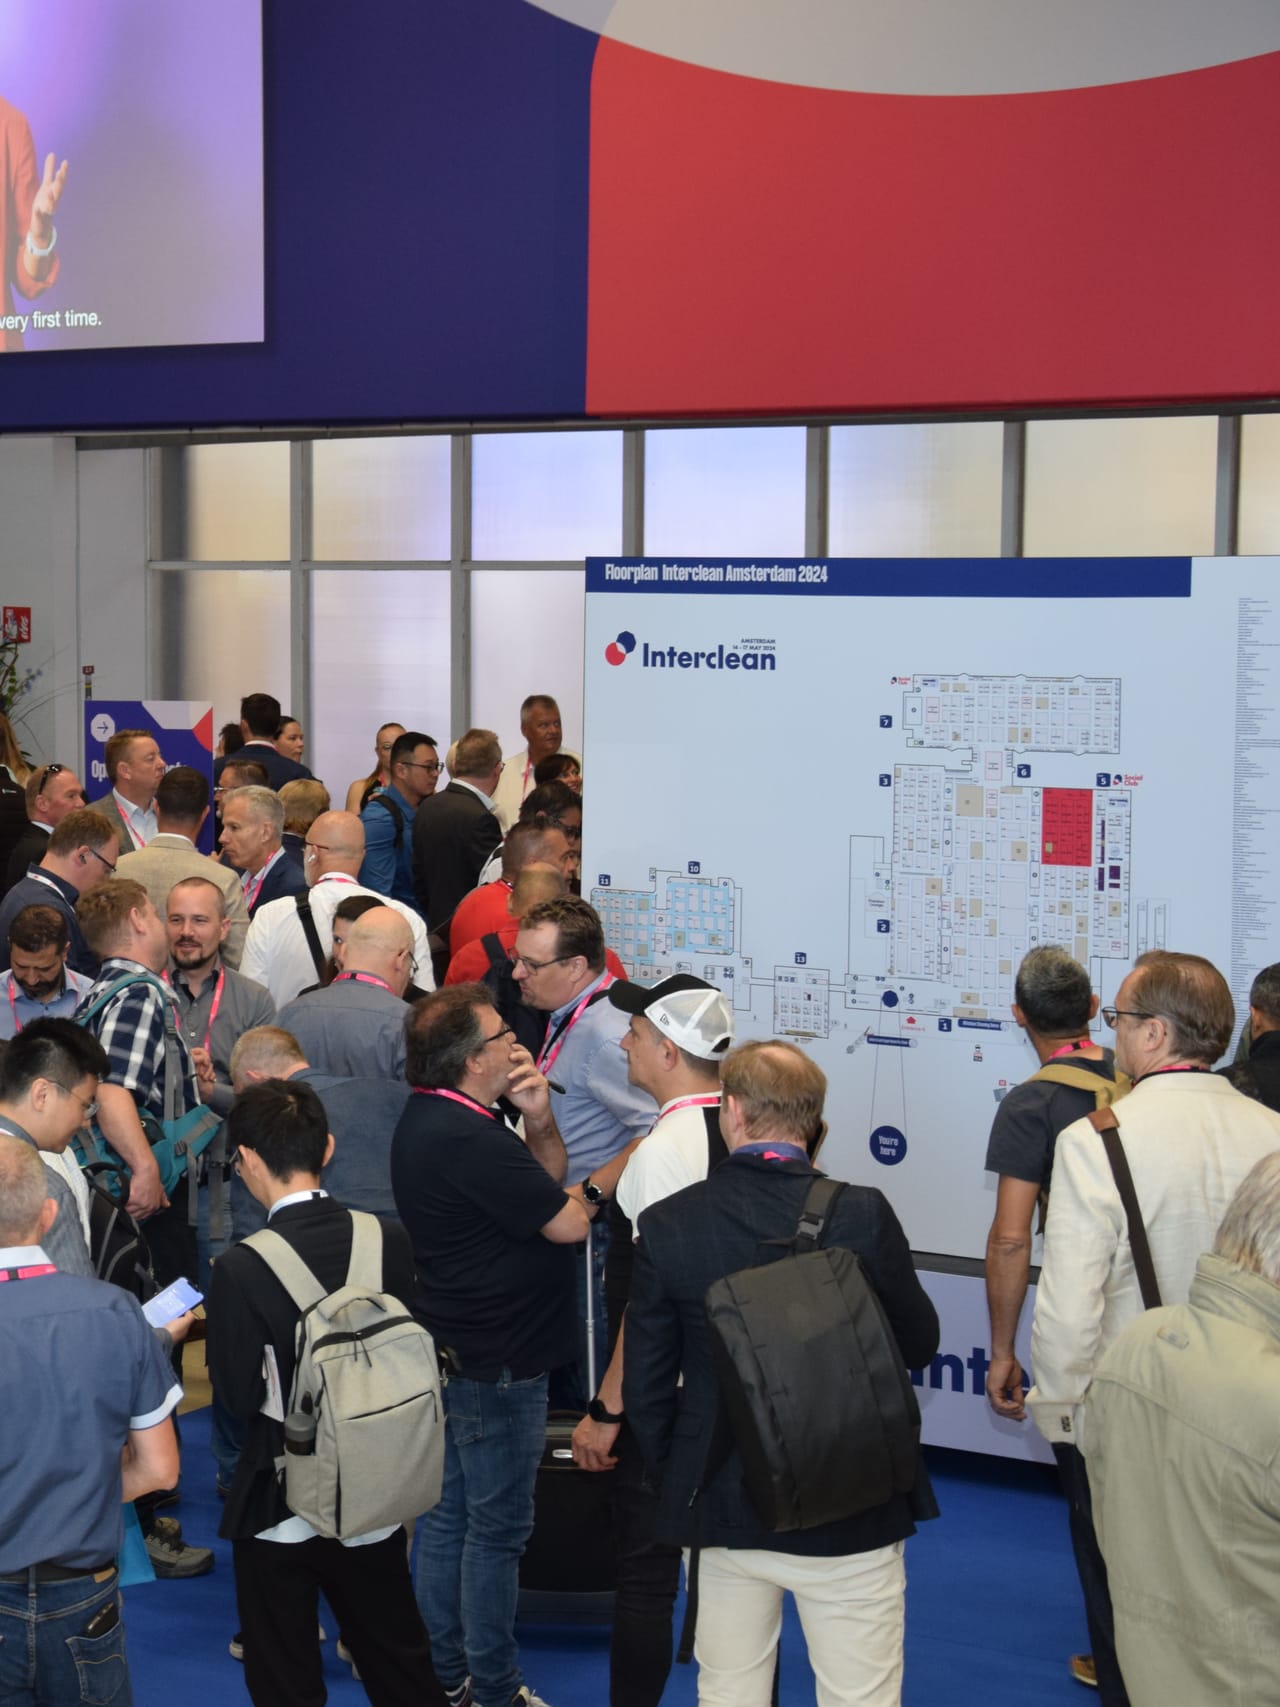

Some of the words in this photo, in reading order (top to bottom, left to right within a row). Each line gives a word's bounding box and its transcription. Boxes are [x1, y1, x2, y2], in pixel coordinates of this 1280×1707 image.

[32, 310, 61, 328] first
[65, 310, 102, 327] time.
[605, 563, 658, 584] Floorplan
[662, 563, 724, 582] Interclean
[725, 564, 797, 583] Amsterdam
[798, 565, 828, 583] 2024
[643, 642, 776, 671] Interclean
[91, 759, 108, 783] Op
[879, 1146, 896, 1156] here
